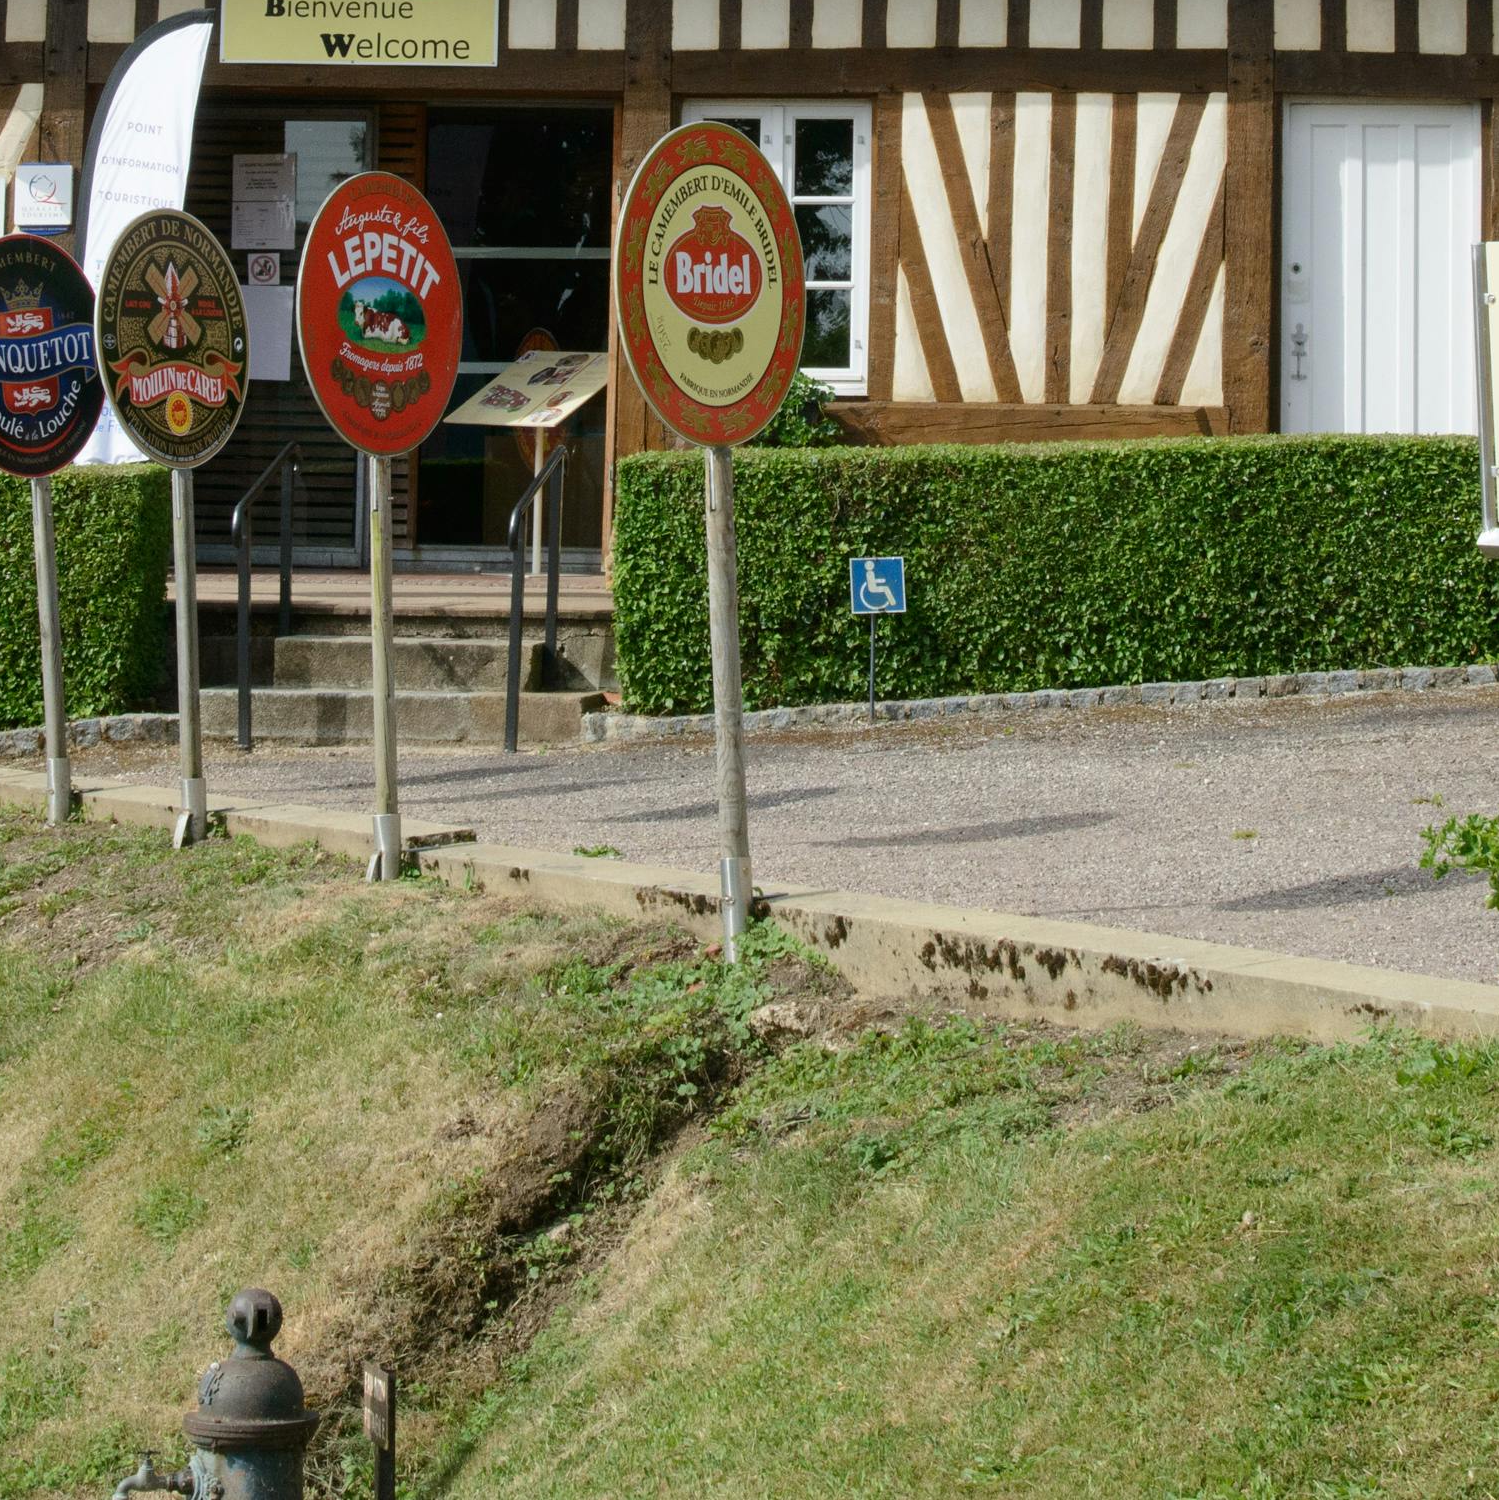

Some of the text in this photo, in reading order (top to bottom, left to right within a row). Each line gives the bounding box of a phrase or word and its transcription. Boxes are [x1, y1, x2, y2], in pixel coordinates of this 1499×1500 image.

[320, 32, 470, 60] Welcome
[127, 121, 163, 136] POINT
[101, 155, 180, 174] D'INFORMATION
[98, 190, 175, 209] TOURISTIQUE
[335, 204, 394, 235] Auguste
[401, 217, 430, 244] fils
[648, 175, 778, 289] LE CAMEMBERT D'EMILE BRIDEL
[103, 219, 243, 329] CAMEMBERT DE NORMANDIE
[327, 231, 441, 300] LEPETIT
[675, 251, 752, 295] Bridel
[339, 341, 423, 376] Fromagers depuis 1872
[132, 367, 225, 403] MOULIN DE CAREL
[709, 389, 719, 398] EN
[718, 372, 754, 398] NORMANDIE
[38, 380, 82, 438] Louche
